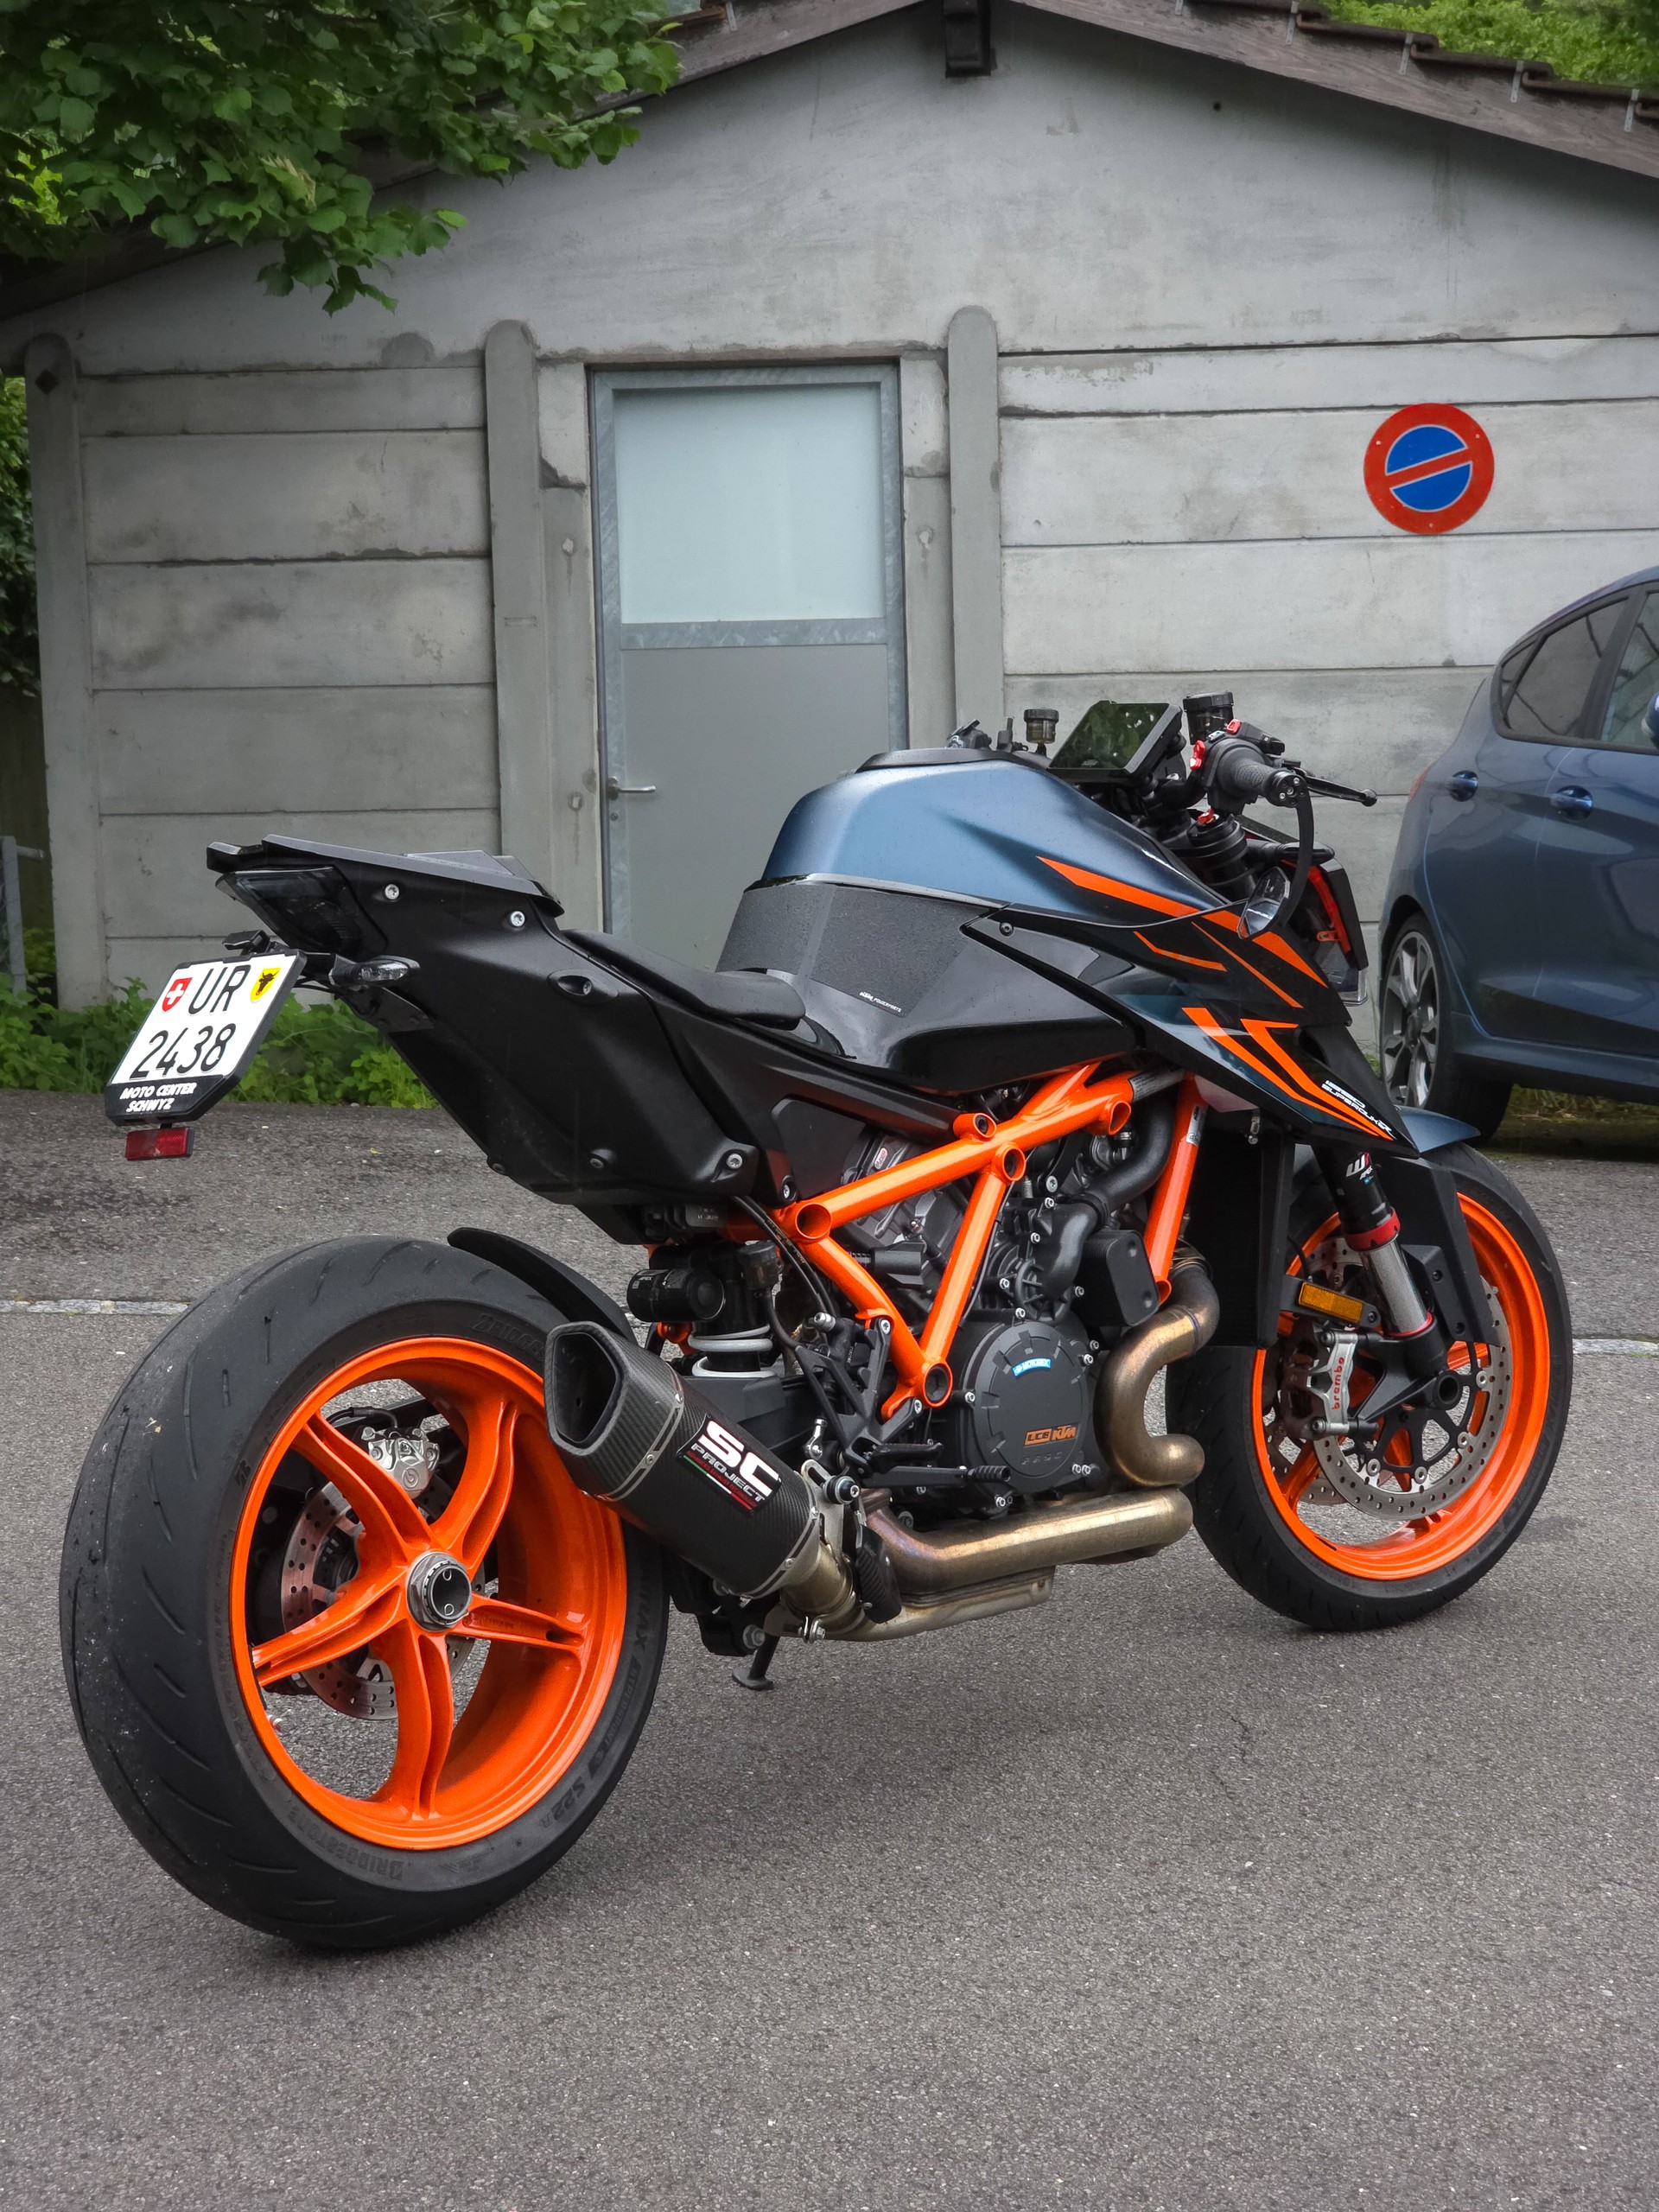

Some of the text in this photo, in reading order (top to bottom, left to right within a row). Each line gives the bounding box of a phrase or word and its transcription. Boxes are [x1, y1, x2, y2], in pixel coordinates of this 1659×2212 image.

[188, 964, 251, 1015] UR
[130, 1023, 237, 1080] 2438
[120, 1082, 197, 1100] MOTO CENTER
[126, 1097, 175, 1113] SCHWYZ
[1332, 1357, 1344, 1410] brembo
[697, 1420, 779, 1497] SC
[1052, 1425, 1077, 1440] KTM
[691, 1443, 765, 1503] PROJECT
[552, 1775, 587, 1821] S22
[287, 1804, 404, 1880] BRIDGESTONE
